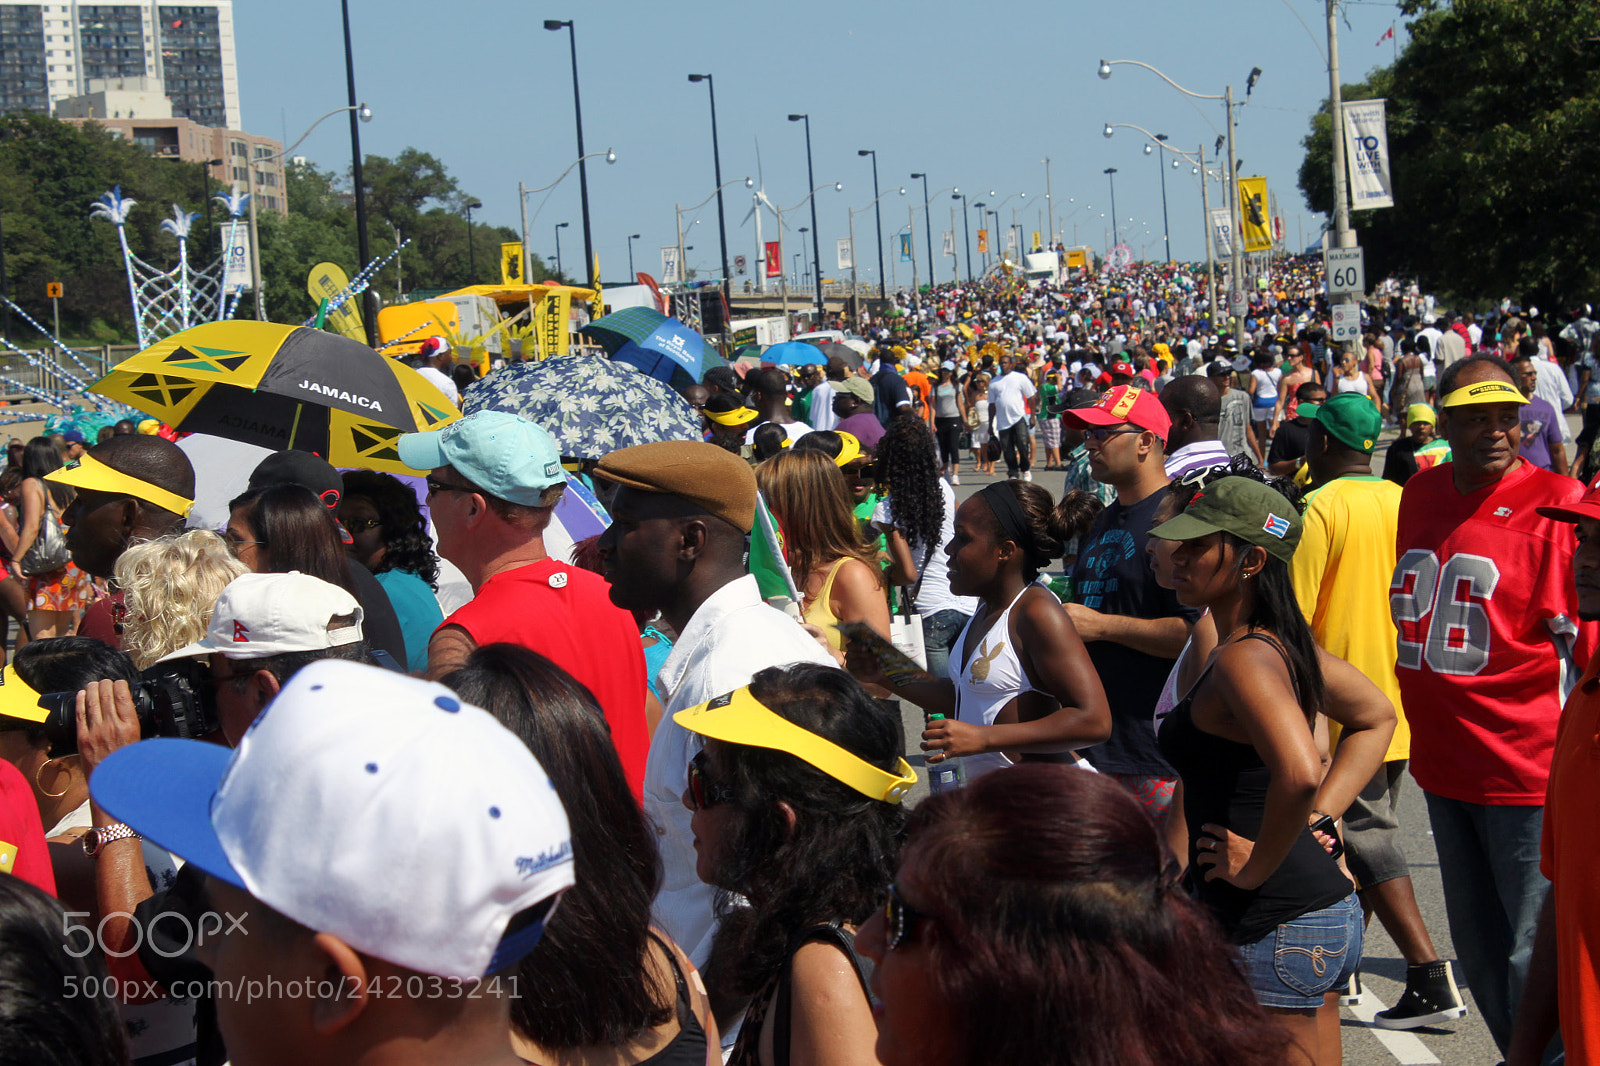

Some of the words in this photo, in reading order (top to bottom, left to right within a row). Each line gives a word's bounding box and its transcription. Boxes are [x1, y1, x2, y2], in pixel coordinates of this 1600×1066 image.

[1354, 136, 1379, 151] TO
[1356, 151, 1380, 161] LIVE
[1357, 161, 1381, 170] WITH
[1328, 252, 1360, 261] MAXIMUM
[1333, 266, 1357, 288] 60
[547, 313, 555, 352] UNION
[553, 296, 561, 352] WESTERN
[298, 380, 383, 412] JAMAICA
[1388, 548, 1501, 677] 26
